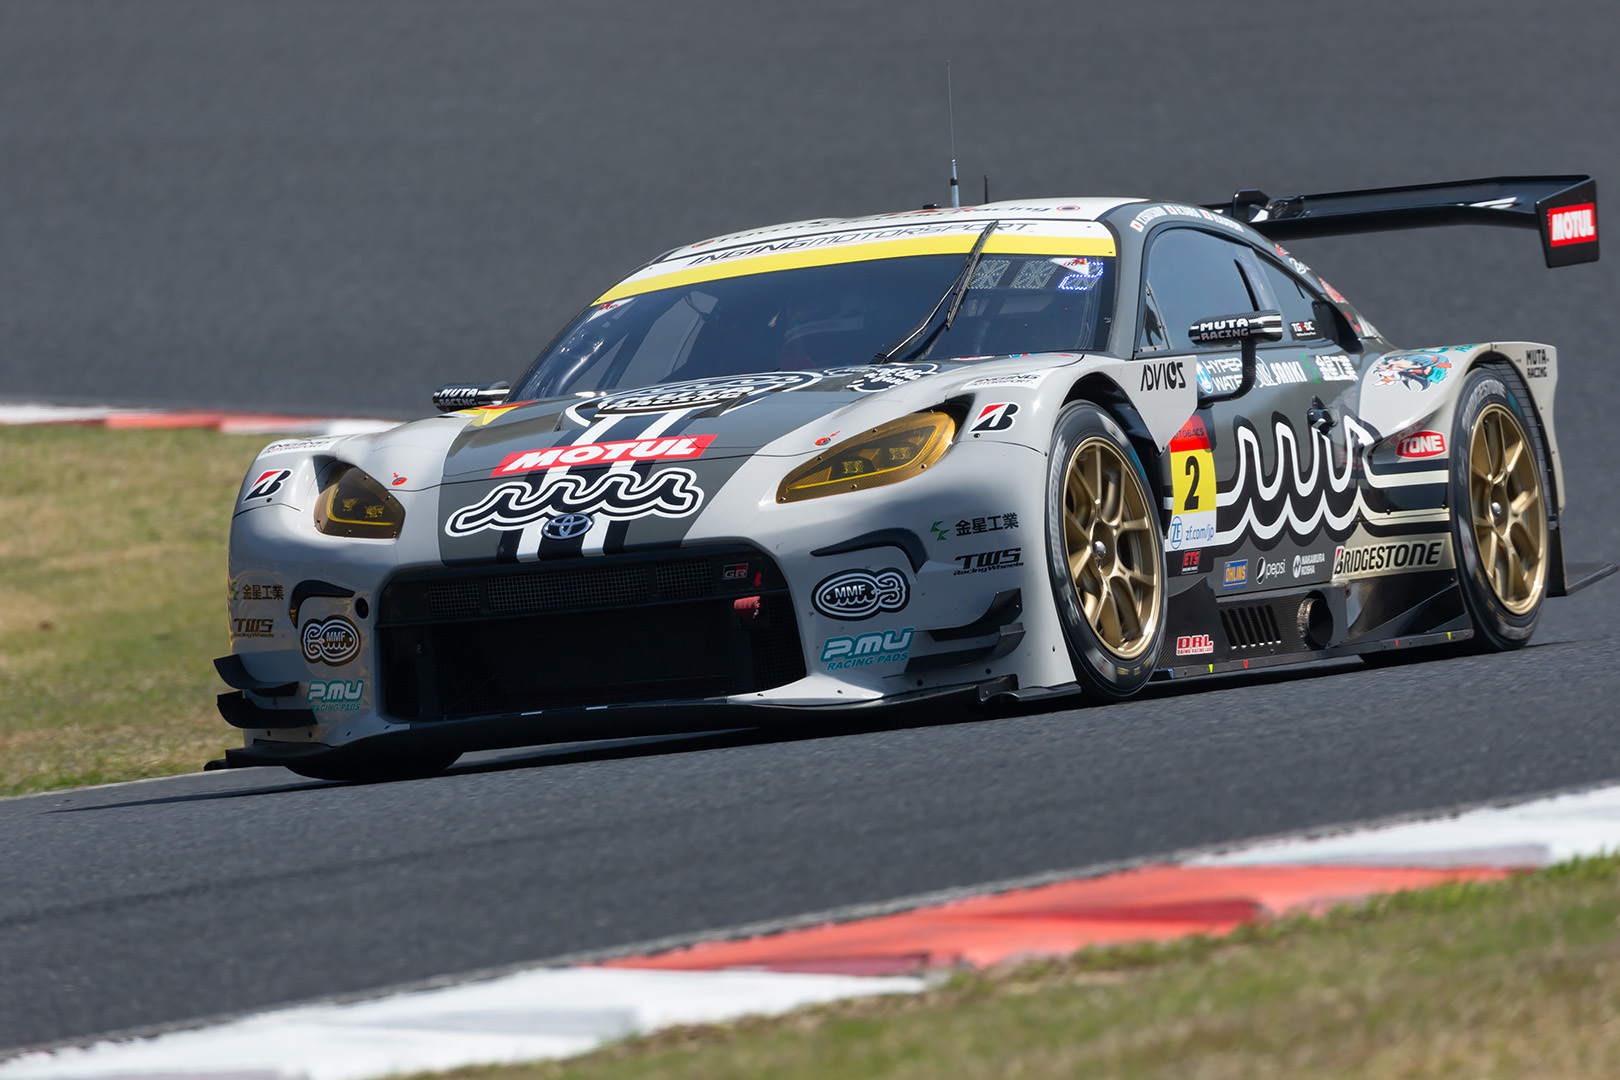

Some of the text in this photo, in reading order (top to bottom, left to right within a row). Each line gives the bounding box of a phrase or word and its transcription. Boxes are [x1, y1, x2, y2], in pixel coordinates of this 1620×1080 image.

[1552, 209, 1594, 241] MOTUL
[1200, 318, 1250, 332] MUTA
[1200, 329, 1250, 341] RACING
[1211, 374, 1243, 391] WATE
[440, 388, 479, 398] MUTA
[1172, 427, 1205, 439] UTOBACS
[1401, 434, 1444, 454] TONE
[502, 438, 699, 472] MOTUL
[1183, 455, 1200, 511] 2
[955, 512, 1019, 537] 金星工業
[954, 547, 1022, 570] TWS
[1183, 551, 1200, 567] ETS
[1334, 541, 1443, 576] BRIDGESTONE
[724, 569, 747, 578] GR
[1265, 558, 1286, 579] pepsi
[242, 584, 285, 600] 金星工業
[834, 584, 866, 599] MMF
[233, 618, 274, 633] TWS
[326, 630, 346, 642] MMF
[1177, 635, 1213, 650] DRL
[826, 652, 909, 671] RACING PADS
[310, 703, 361, 712] RACING PADS
